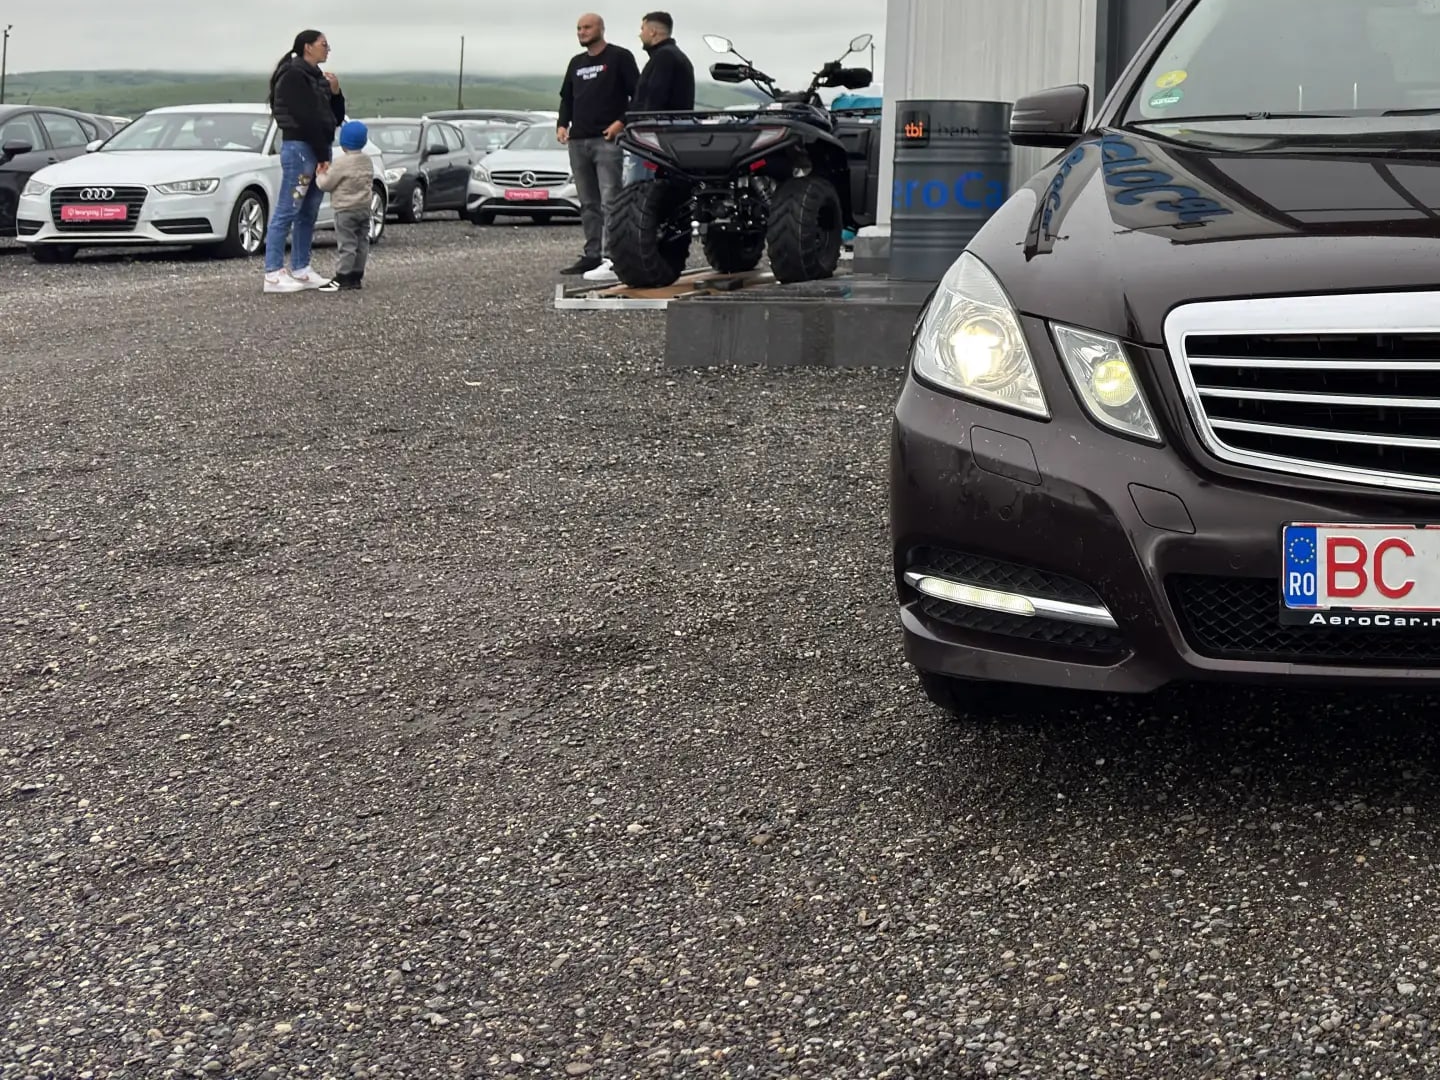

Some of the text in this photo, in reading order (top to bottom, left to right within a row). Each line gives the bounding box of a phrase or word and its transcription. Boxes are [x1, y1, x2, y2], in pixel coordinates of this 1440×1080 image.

[904, 121, 924, 138] tbi
[1325, 536, 1416, 600] BC
[1289, 571, 1315, 597] RO
